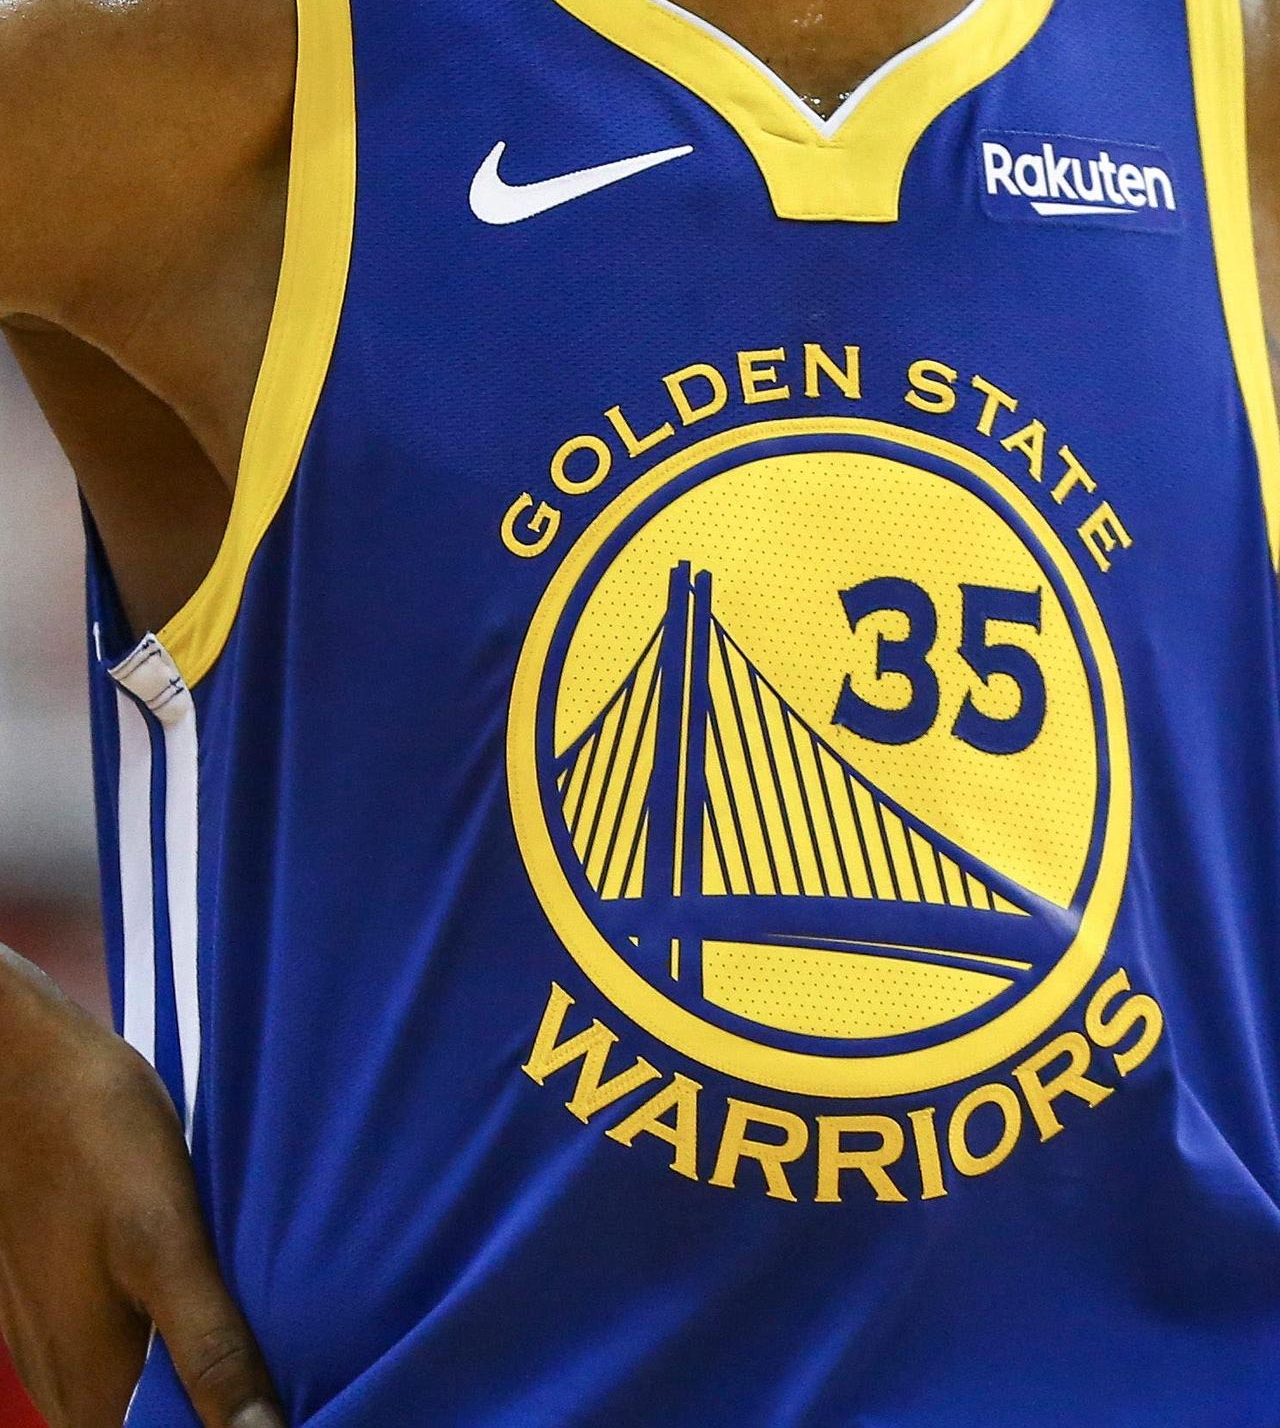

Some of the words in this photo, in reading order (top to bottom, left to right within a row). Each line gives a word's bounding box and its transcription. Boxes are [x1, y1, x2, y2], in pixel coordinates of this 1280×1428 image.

[982, 142, 1176, 210] Rakuten
[500, 343, 861, 560] GOLDEN
[904, 359, 1133, 572] STATE
[831, 576, 1047, 755] 35
[521, 967, 1164, 1204] WARRIORS
